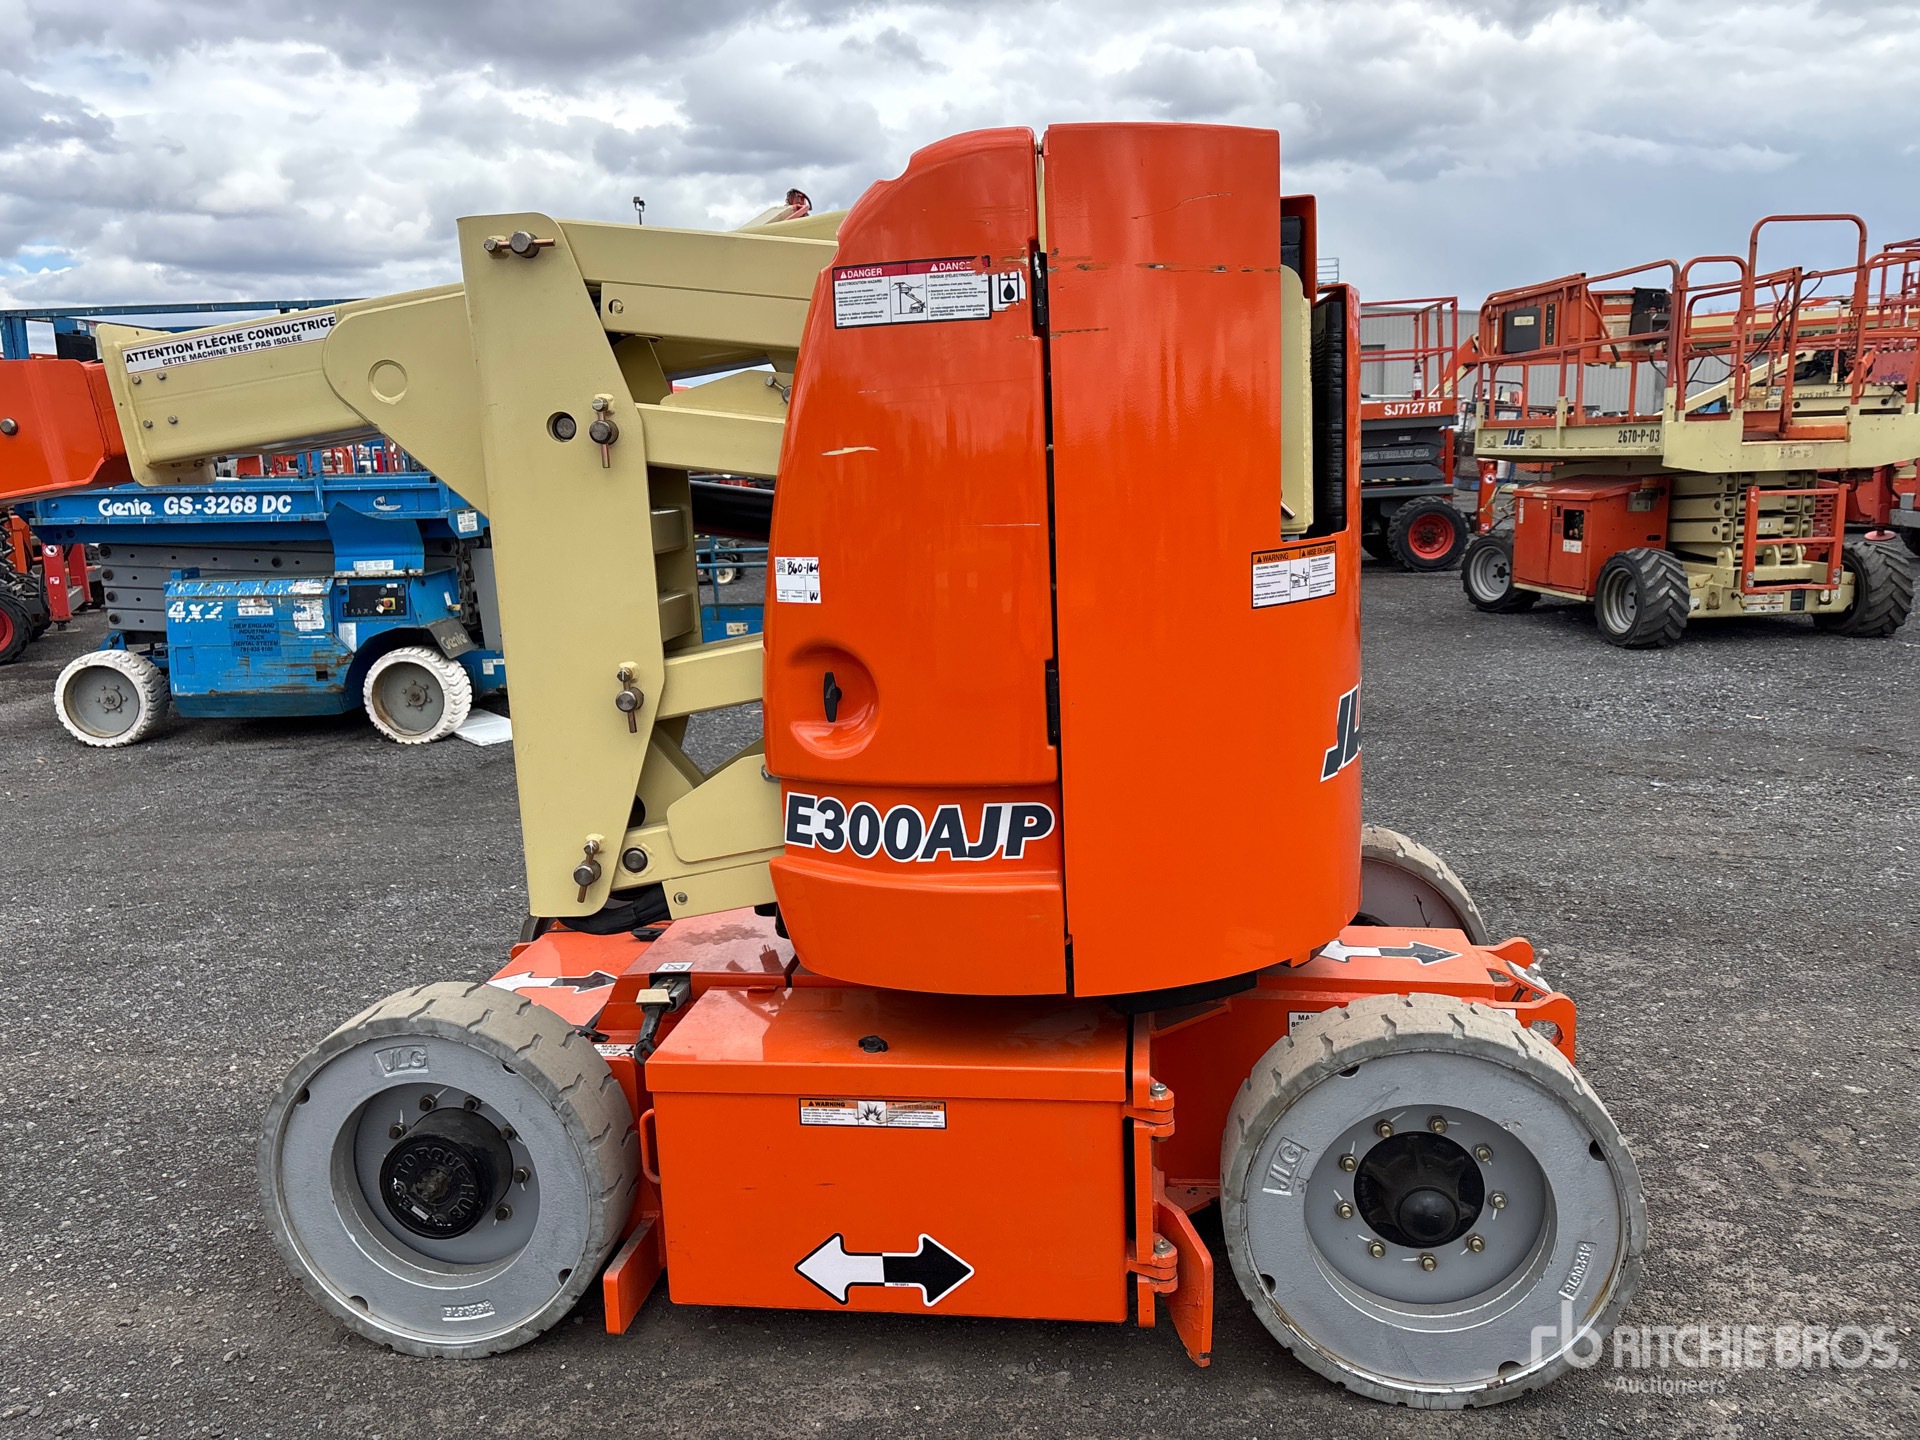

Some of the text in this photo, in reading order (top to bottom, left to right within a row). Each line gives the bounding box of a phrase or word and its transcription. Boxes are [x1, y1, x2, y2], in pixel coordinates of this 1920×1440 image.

[847, 267, 883, 279] DANGER
[125, 316, 337, 364] ATTENTION FLÈCHE CONDUCTRICE
[162, 333, 303, 366] CETTE MACHINE N'EST PAS ISOLÉE
[1384, 400, 1444, 416] SJ7127 RT
[1503, 429, 1526, 446] JLG
[1618, 429, 1661, 443] 2670-P-03
[98, 494, 292, 517] Genie GS-3268 DC
[1262, 553, 1289, 562] WARNING
[440, 632, 468, 650] Genie
[1320, 680, 1362, 782] JL
[785, 792, 1055, 863] E300AJP
[384, 1048, 427, 1072] JLG
[1270, 1143, 1301, 1190] JLG
